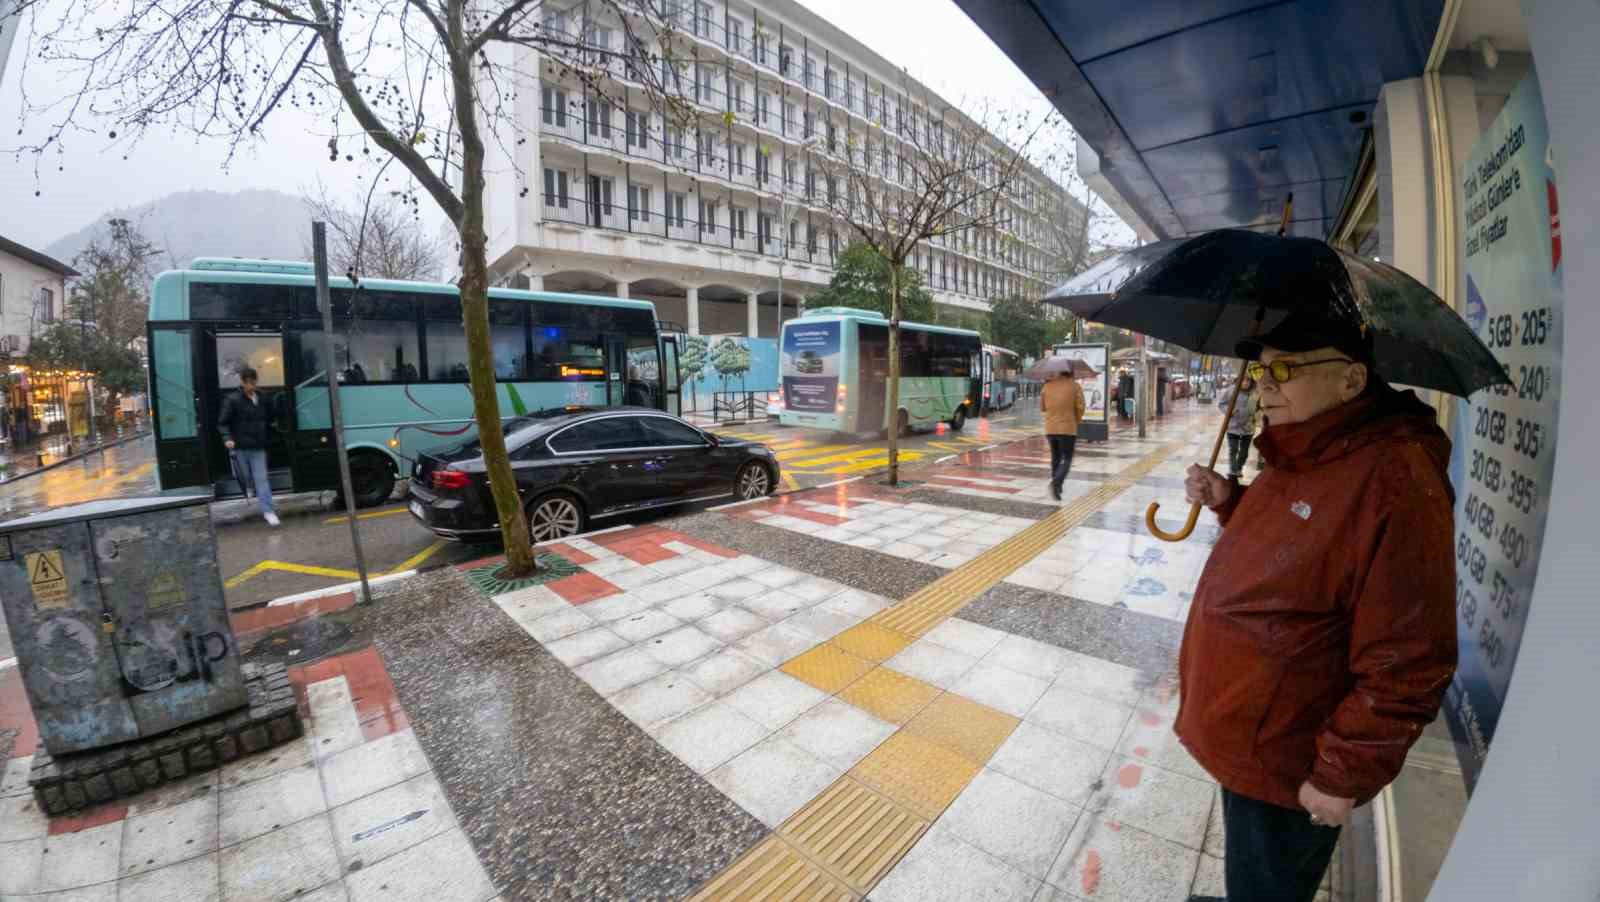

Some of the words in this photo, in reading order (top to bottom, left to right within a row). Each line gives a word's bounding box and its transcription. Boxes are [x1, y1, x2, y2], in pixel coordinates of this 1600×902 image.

[1487, 317, 1495, 348] 5
[1496, 314, 1512, 348] GB
[1521, 308, 1546, 346] 205
[1519, 365, 1544, 402] 240
[1475, 405, 1488, 438] 20
[1490, 409, 1506, 445] GB
[1514, 418, 1540, 459] 305
[1470, 449, 1484, 481] 30
[1485, 456, 1501, 493] GB
[1507, 470, 1534, 514] 395
[1464, 493, 1478, 525] 40
[1478, 502, 1494, 540] GB
[1500, 522, 1525, 568] 490
[1470, 547, 1486, 584] GB
[1490, 570, 1514, 619] 575
[1480, 618, 1504, 668] 640
